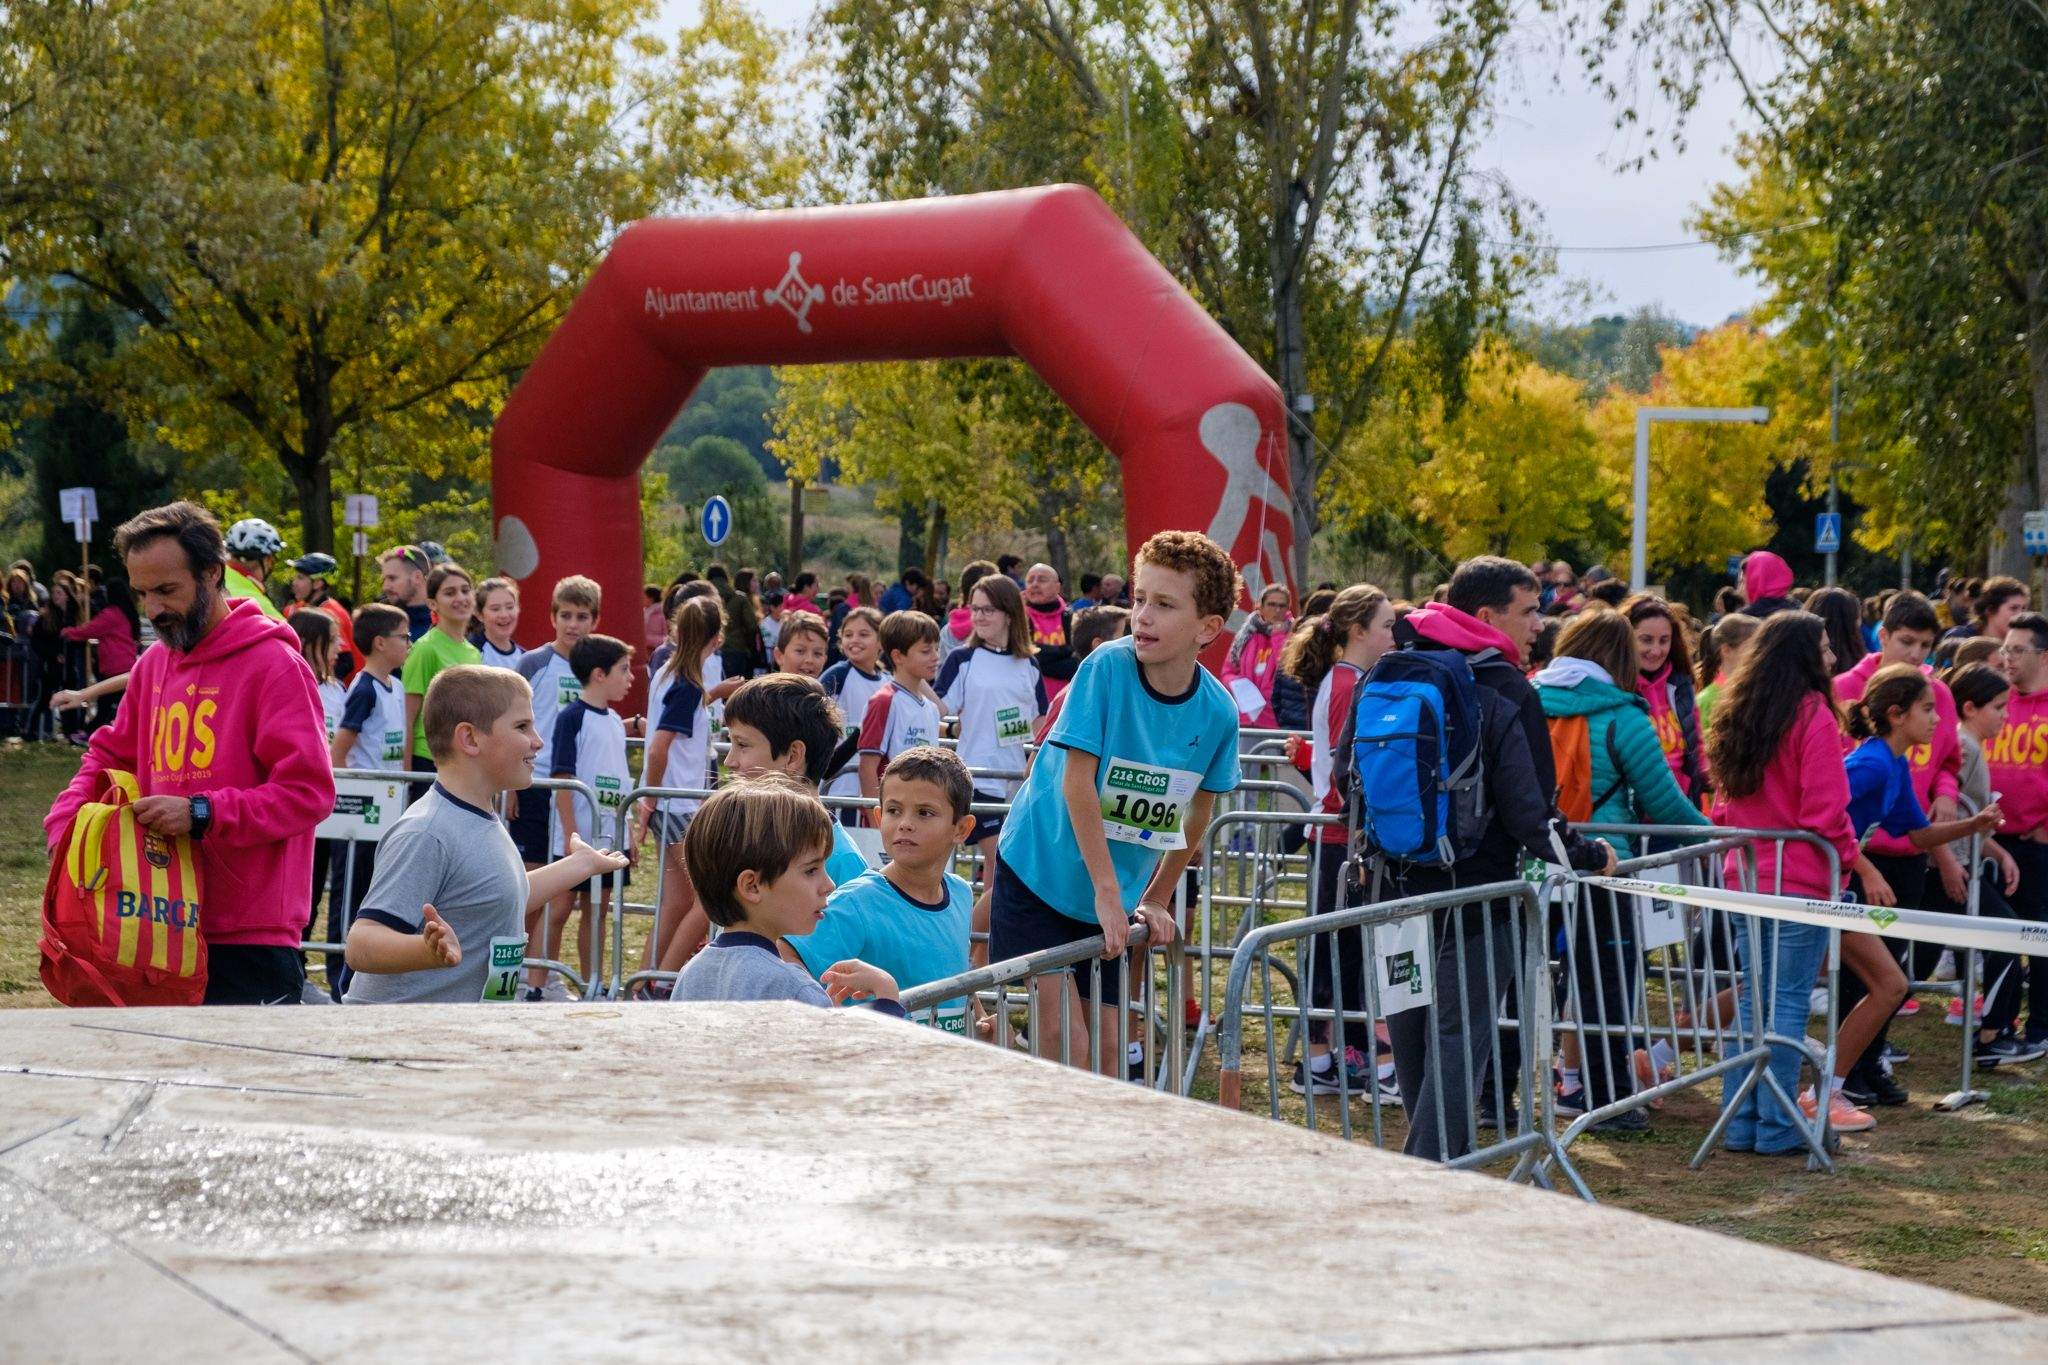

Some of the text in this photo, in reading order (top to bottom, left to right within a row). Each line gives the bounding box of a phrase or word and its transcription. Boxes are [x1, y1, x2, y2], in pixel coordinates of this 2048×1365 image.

[643, 272, 975, 319] Ajuntament de SantCugat
[1112, 770, 1134, 781] 21è
[1136, 773, 1167, 787] CROS
[1110, 794, 1177, 828] 1096
[496, 947, 512, 959] 21è
